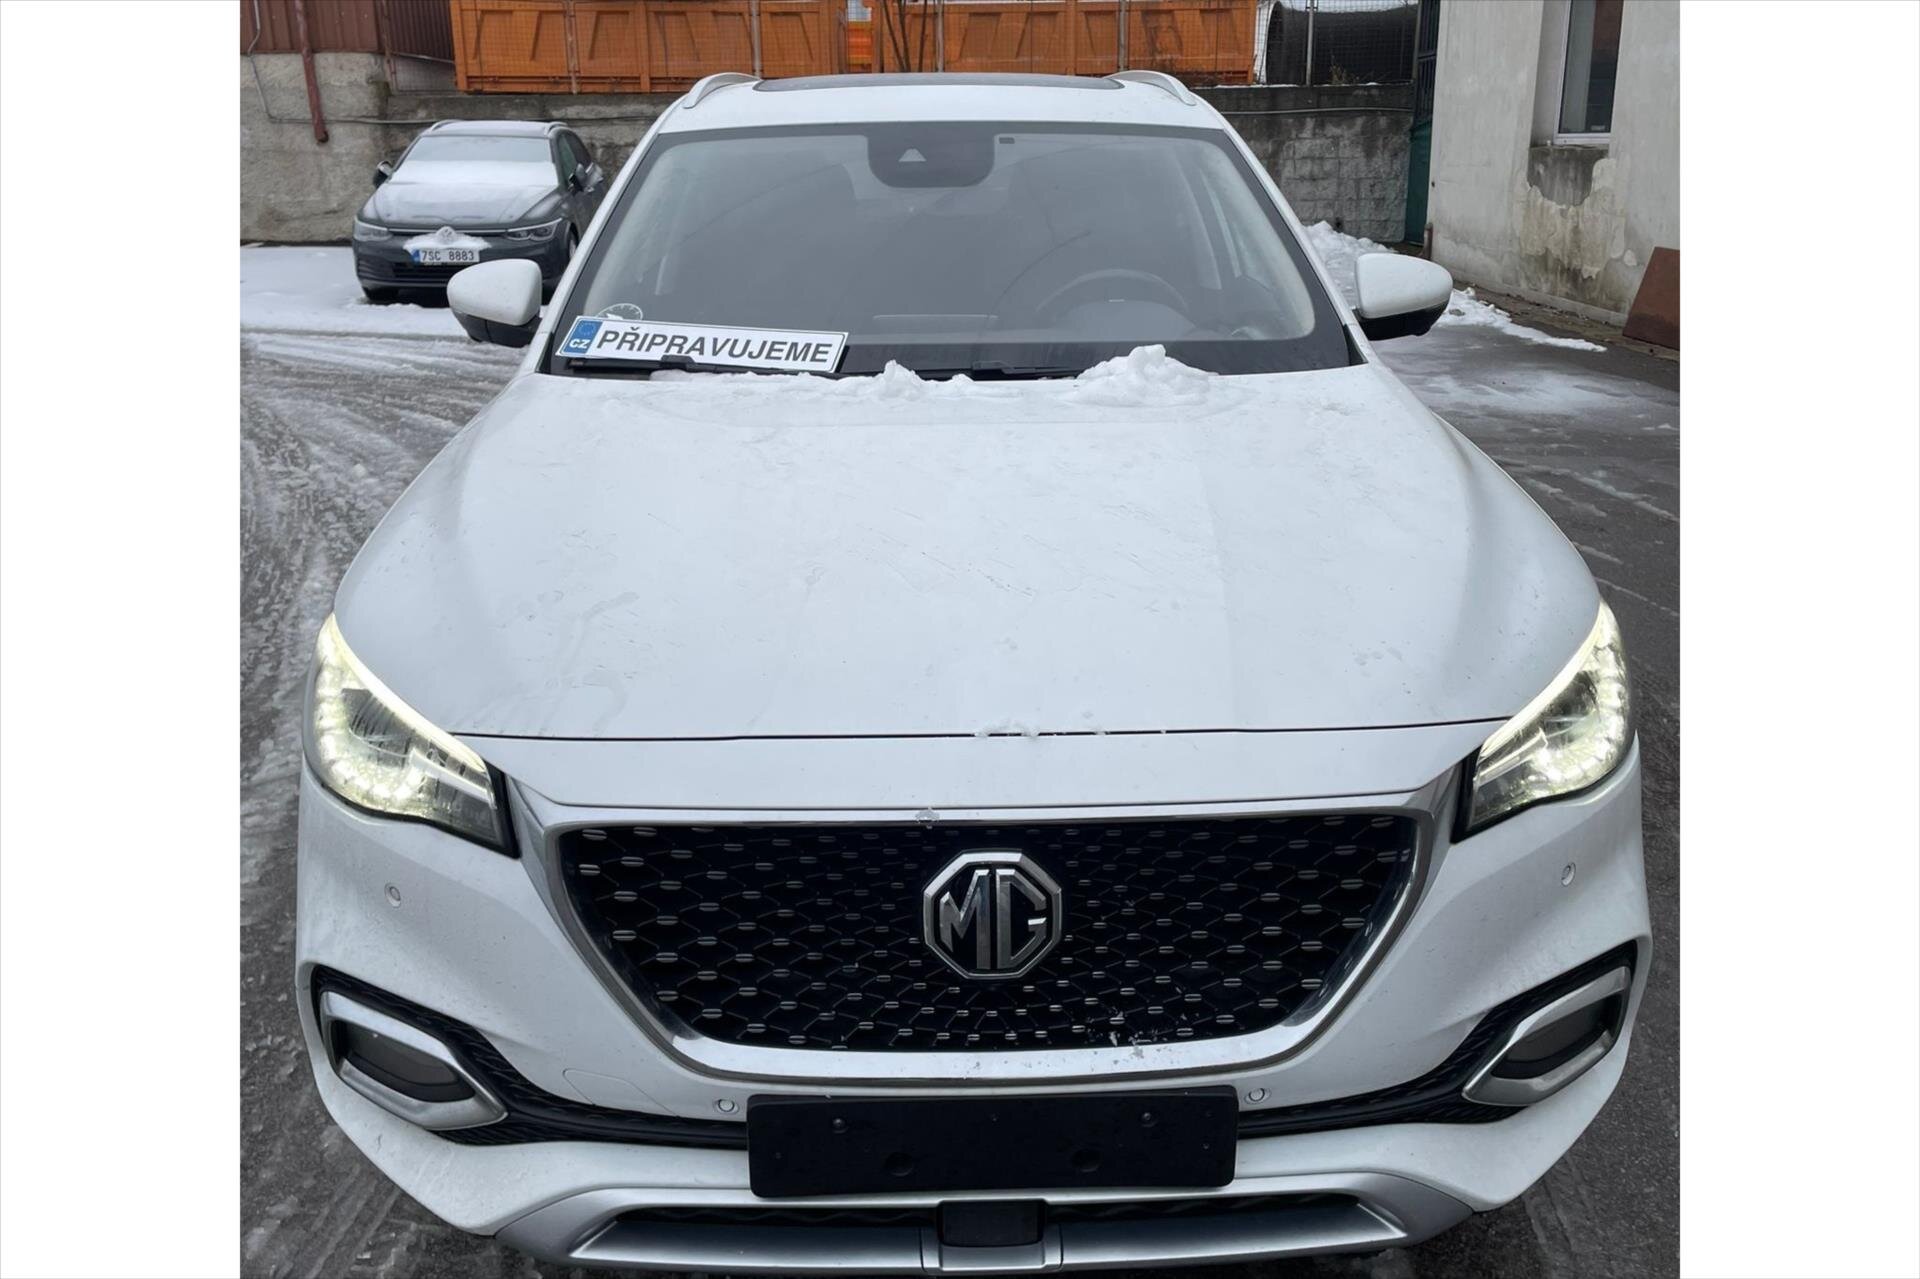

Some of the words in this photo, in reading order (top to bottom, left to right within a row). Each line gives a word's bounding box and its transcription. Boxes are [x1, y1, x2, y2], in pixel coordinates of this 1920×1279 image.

[422, 250, 441, 261] 7SC
[448, 250, 474, 261] 8883
[569, 338, 591, 349] CZ
[596, 326, 833, 363] PŘIPRAVUJEME
[940, 869, 1047, 969] MG
